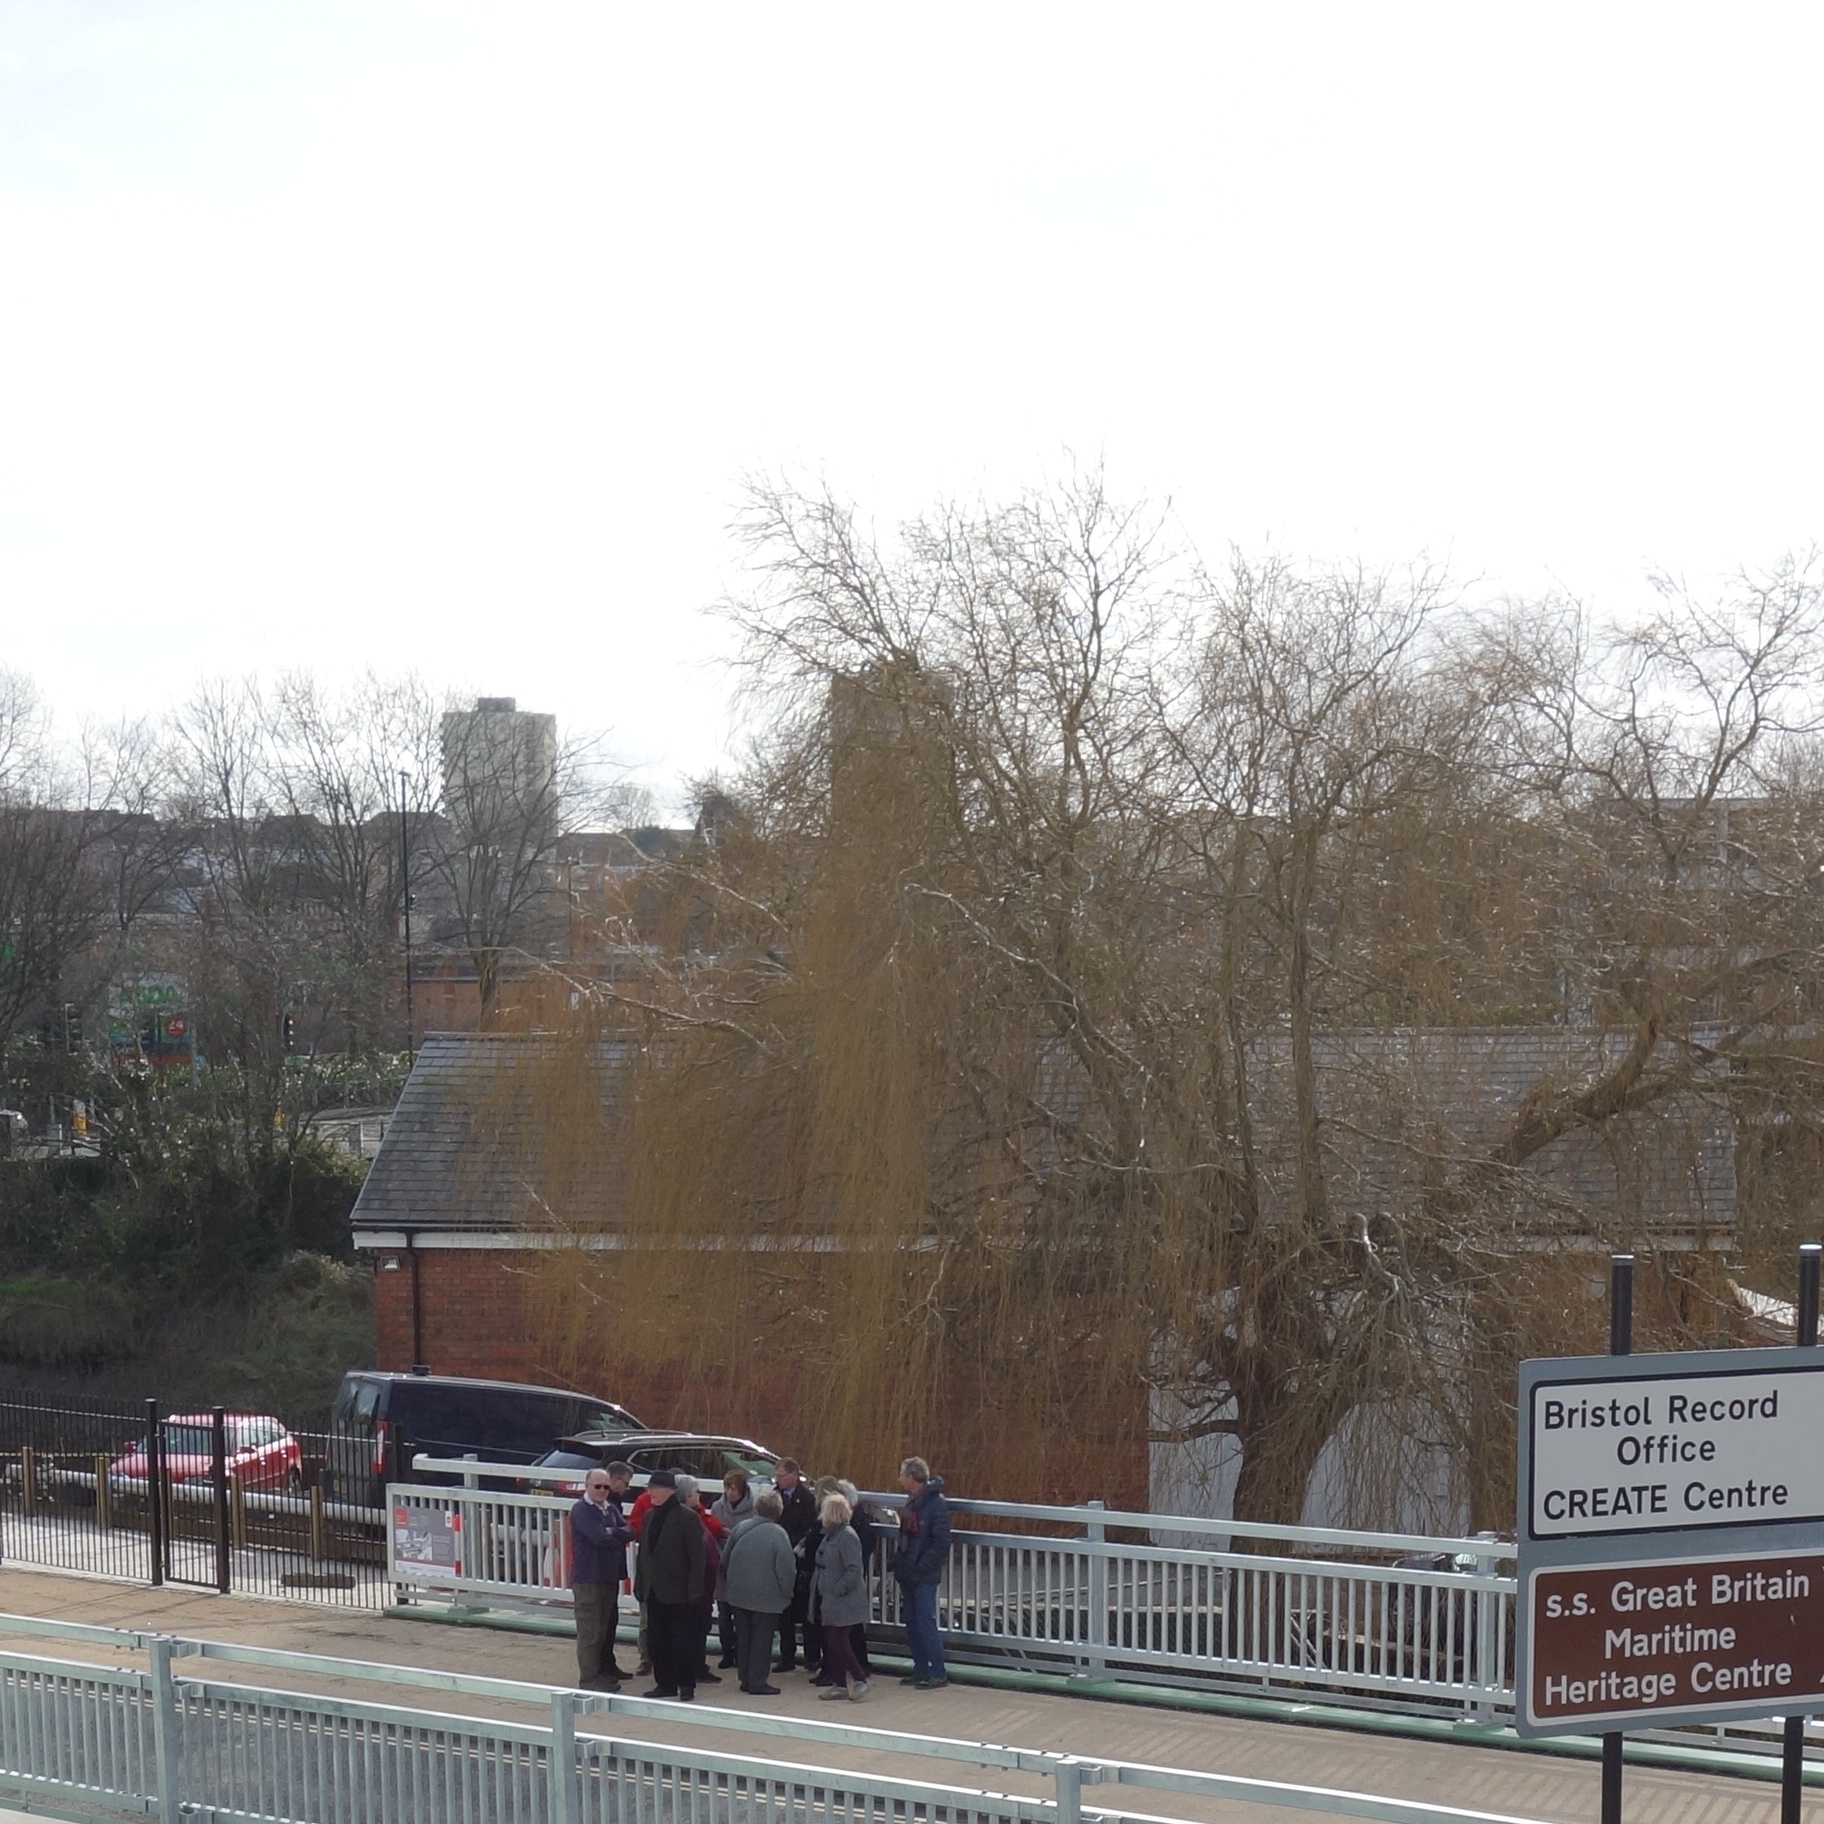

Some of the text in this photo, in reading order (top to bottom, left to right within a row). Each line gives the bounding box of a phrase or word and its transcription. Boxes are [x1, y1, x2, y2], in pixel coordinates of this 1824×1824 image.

[1544, 1389, 1778, 1430] Bristol Record
[1617, 1434, 1716, 1466] Office
[1543, 1479, 1789, 1520] CREATE Centre
[1545, 1569, 1810, 1618] s.s. Great Britain
[1604, 1623, 1736, 1659] Maritime
[1545, 1658, 1792, 1706] Heritage Centre
